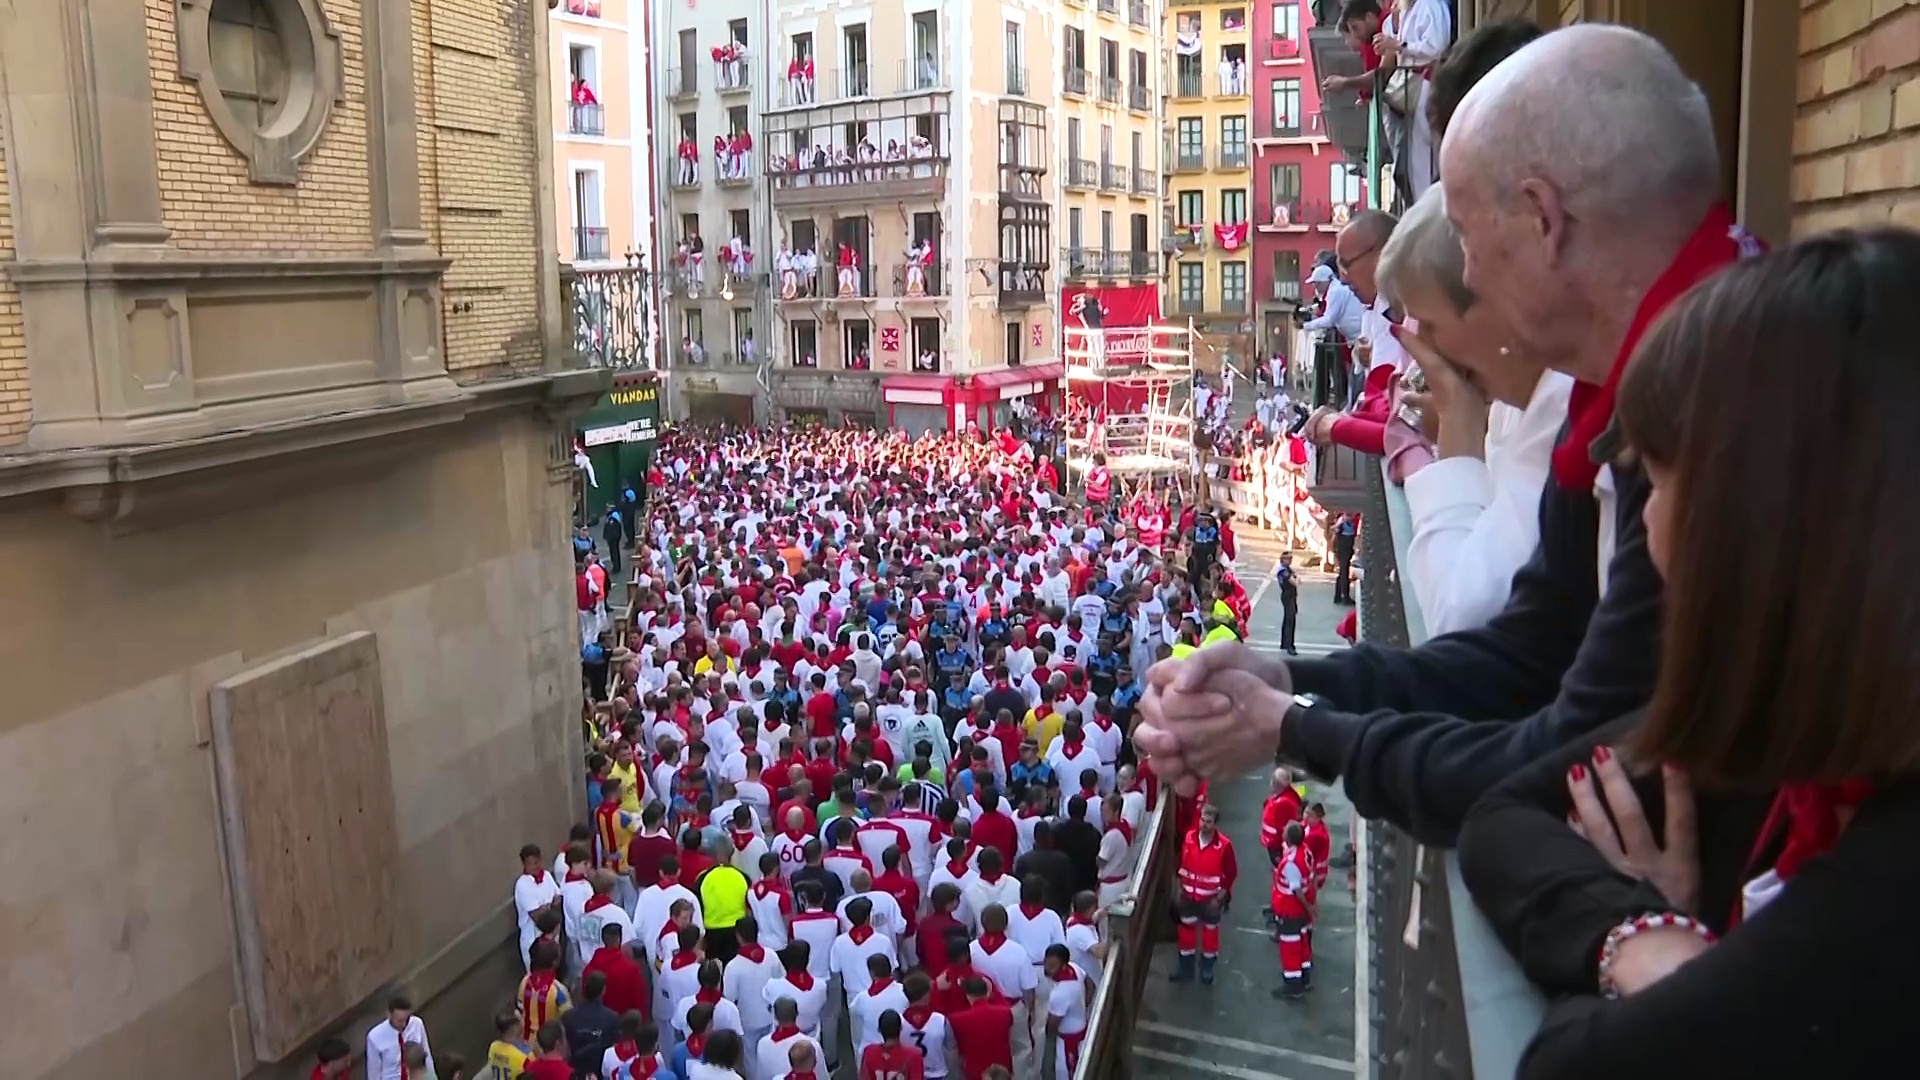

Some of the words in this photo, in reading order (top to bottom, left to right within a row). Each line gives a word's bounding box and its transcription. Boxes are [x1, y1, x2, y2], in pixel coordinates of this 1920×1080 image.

[610, 389, 656, 404] VIANDAS
[969, 595, 977, 609] 4
[780, 843, 805, 863] 60
